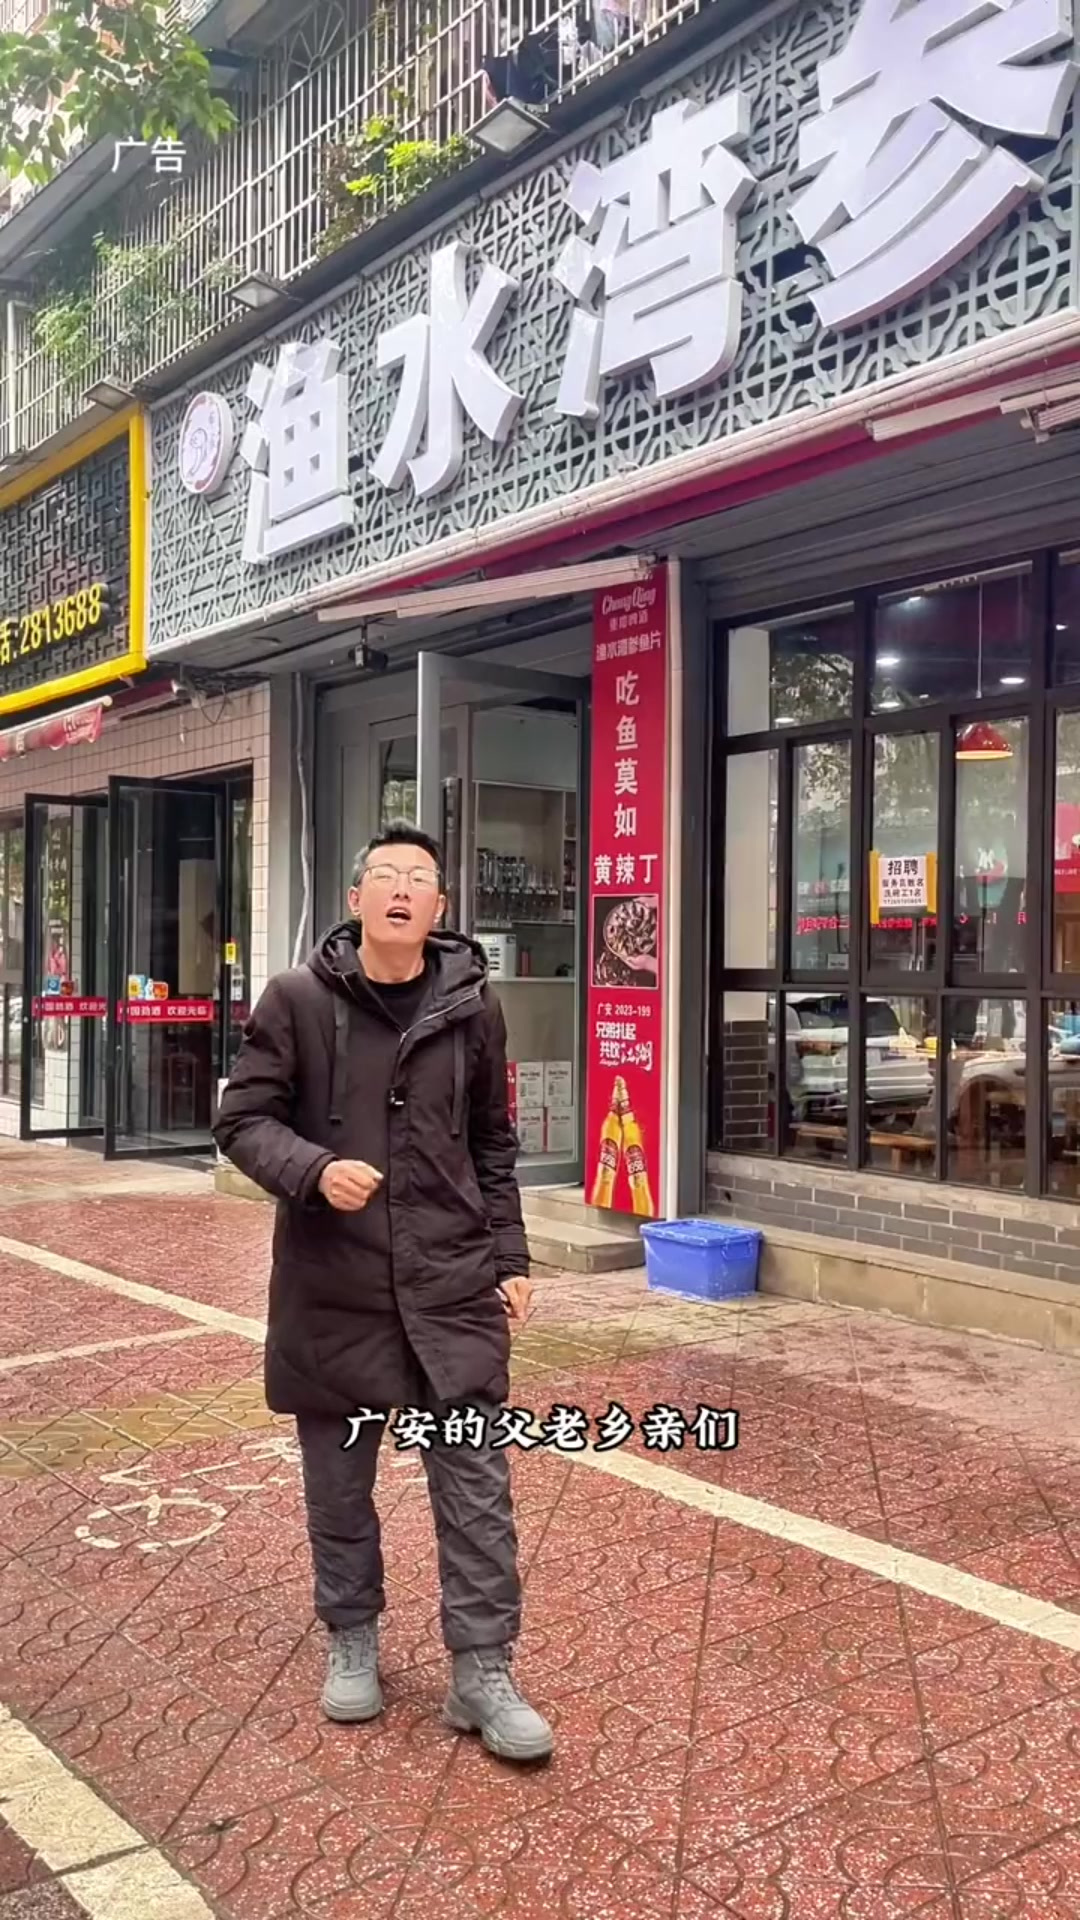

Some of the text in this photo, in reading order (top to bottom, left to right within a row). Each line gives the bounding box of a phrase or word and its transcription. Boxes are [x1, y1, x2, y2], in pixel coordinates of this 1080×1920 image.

[613, 669, 640, 838] 吃鱼莫如
[593, 852, 658, 886] 黄辣丁
[887, 859, 919, 876] 招聘
[167, 1005, 207, 1016] 欢迎光临
[597, 1002, 613, 1016] 广安
